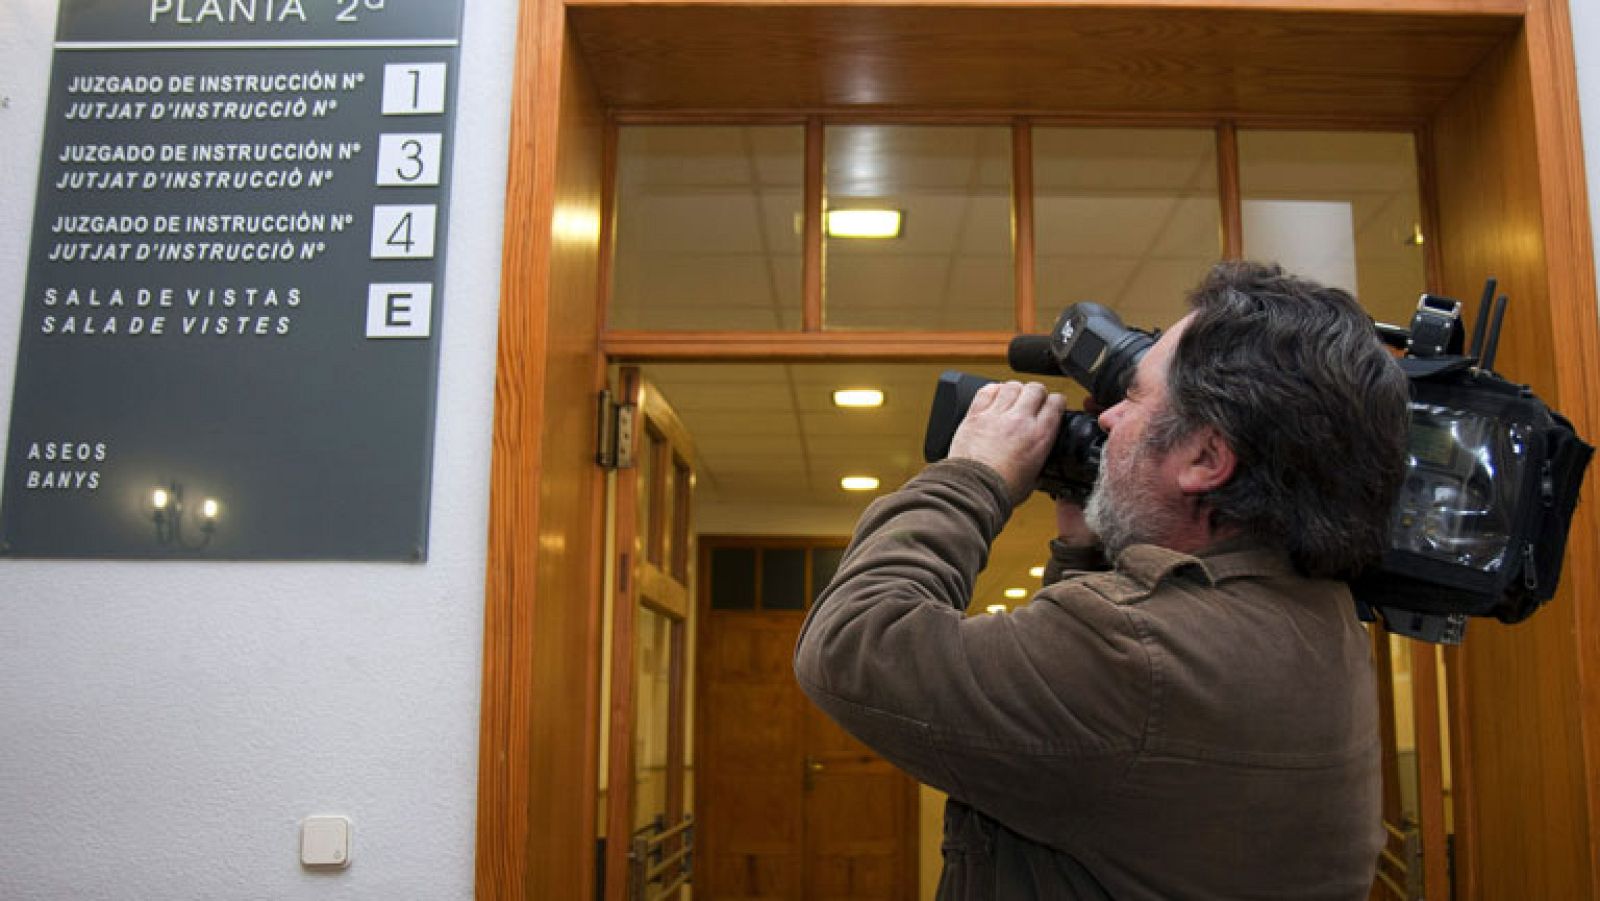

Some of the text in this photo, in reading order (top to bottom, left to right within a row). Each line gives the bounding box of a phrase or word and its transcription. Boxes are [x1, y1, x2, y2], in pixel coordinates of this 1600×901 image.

[69, 77, 163, 92] JUZGADO
[169, 77, 194, 92] DE
[200, 71, 336, 92] INSTRUCCIÓN
[65, 102, 146, 119] JUTJAT
[60, 146, 154, 161] JUZGADO
[161, 146, 186, 161] DE
[193, 140, 332, 161] INSTRUCCIÓN
[397, 139, 424, 182] 3
[56, 173, 138, 188] JUTJAT
[52, 217, 148, 232] JUZGADO
[154, 217, 180, 232] DE
[187, 212, 325, 232] INSTRUCCIÓN
[386, 211, 415, 254] 4
[50, 244, 131, 260] JUTJAT
[45, 288, 300, 306] SALA DE VISTAS
[385, 294, 412, 326] E
[42, 317, 289, 334] SALA DE VISTES
[29, 442, 106, 461] ASEOS
[27, 471, 100, 488] BANYS
